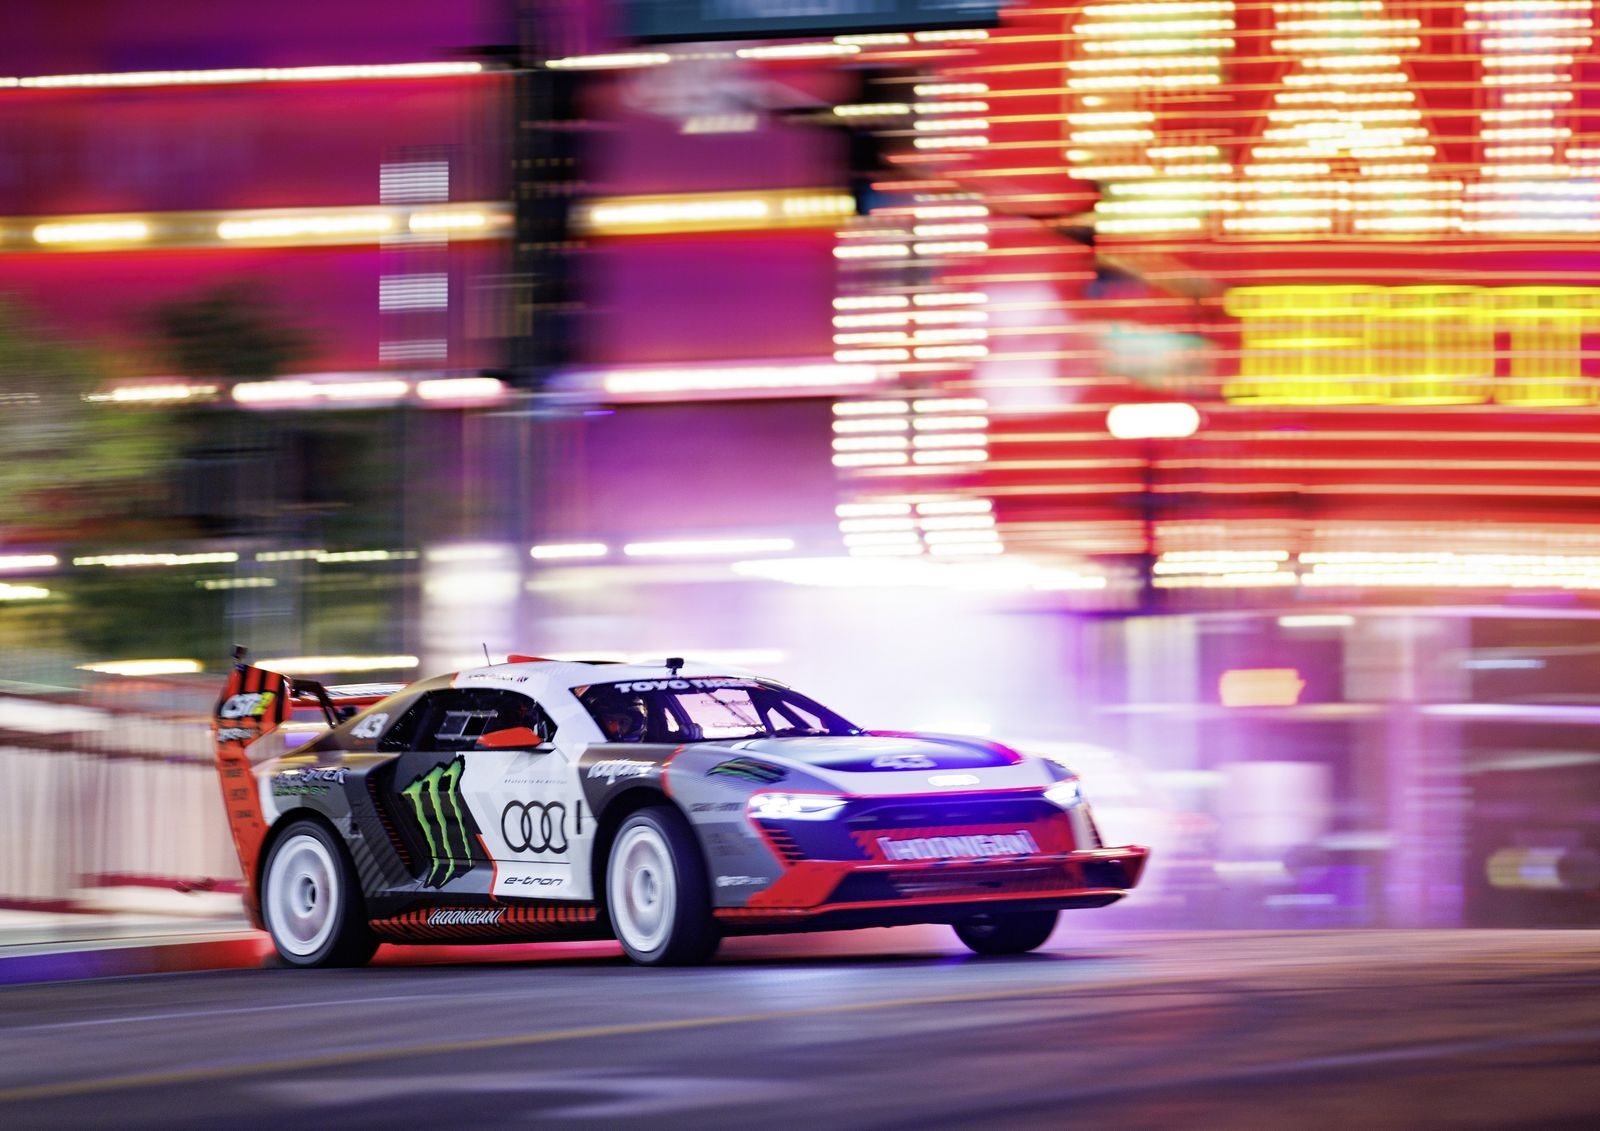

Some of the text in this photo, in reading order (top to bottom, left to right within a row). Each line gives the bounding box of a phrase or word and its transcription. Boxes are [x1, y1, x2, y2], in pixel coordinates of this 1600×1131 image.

[614, 680, 690, 694] TOYO
[350, 712, 389, 738] 43
[871, 754, 937, 769] 43
[504, 876, 564, 886] e-tron
